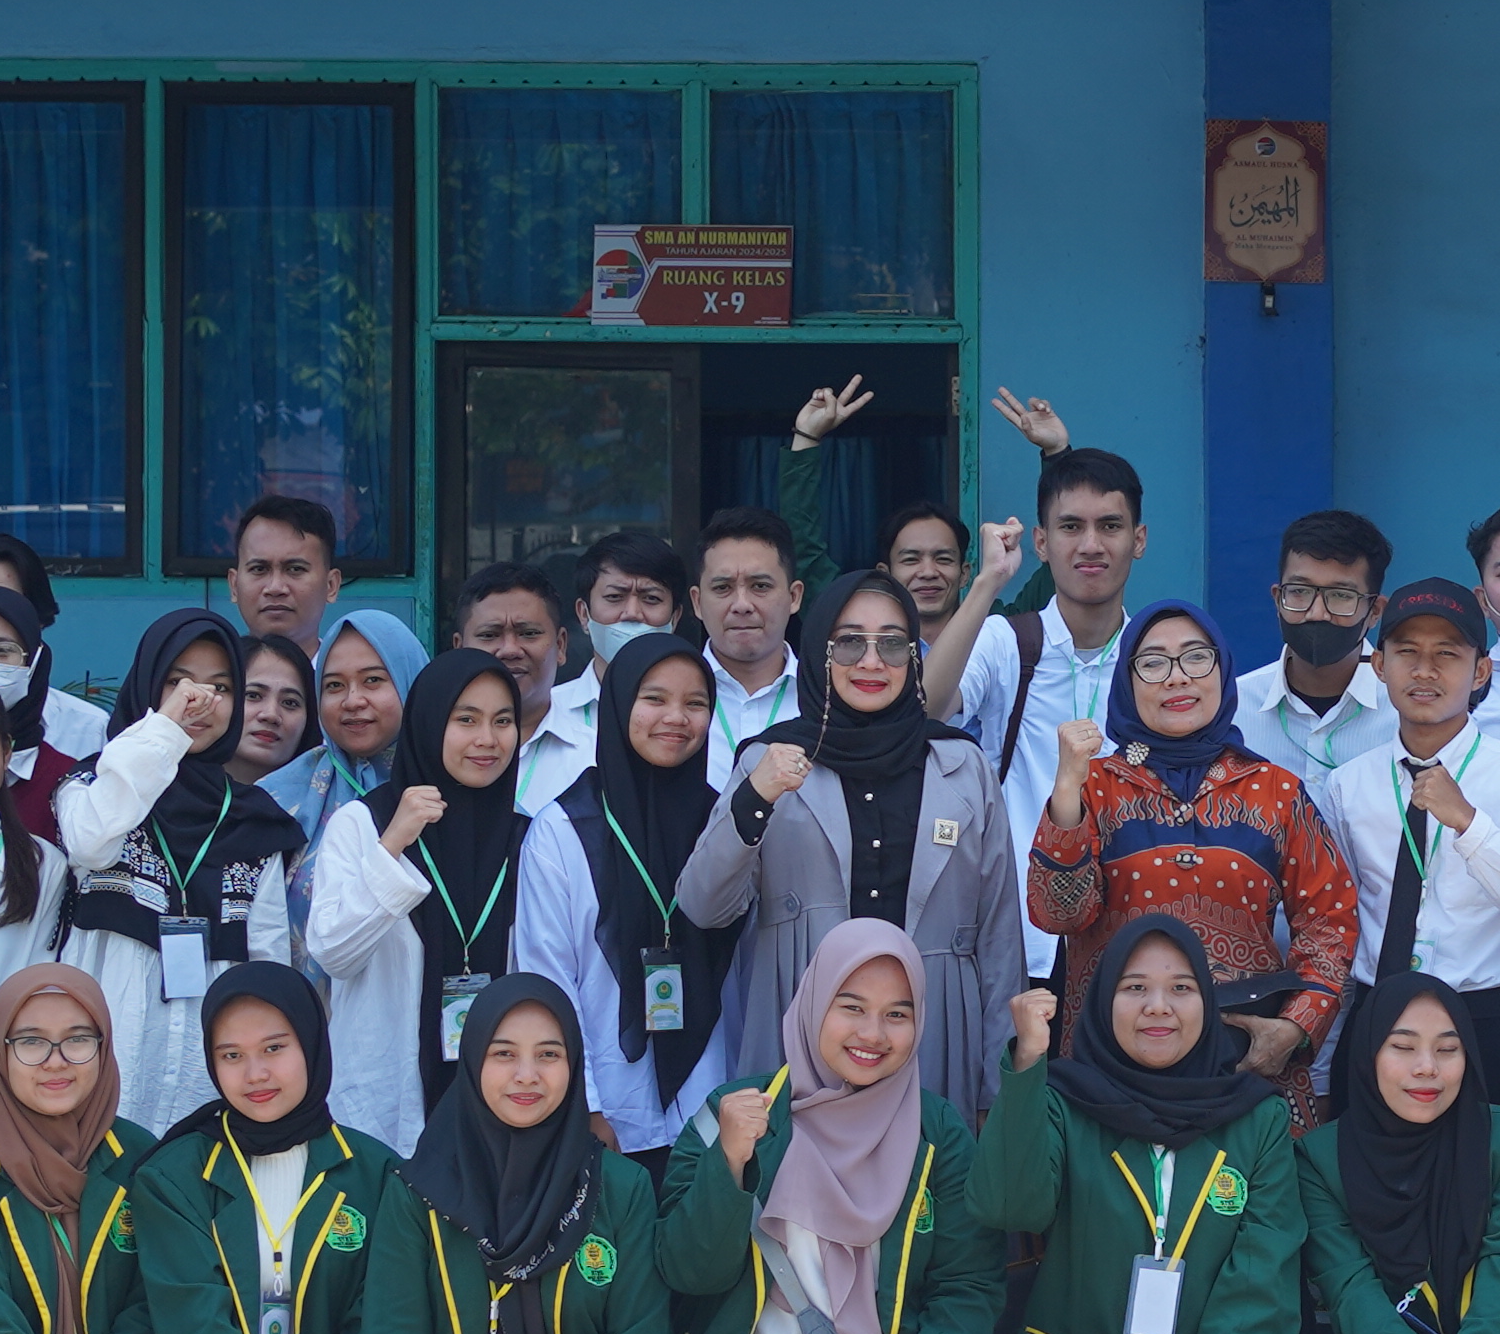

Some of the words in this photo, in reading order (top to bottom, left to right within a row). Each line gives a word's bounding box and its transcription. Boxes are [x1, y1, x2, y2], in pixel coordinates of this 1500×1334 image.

[644, 231, 674, 245] SMA
[678, 231, 696, 245] AN
[699, 231, 786, 245] NURMANIYAH
[665, 246, 700, 256] TAHUN
[739, 247, 786, 256] 2024/2025
[663, 270, 726, 286] RUANG
[733, 270, 786, 286] KELAS
[703, 291, 746, 314] X-9
